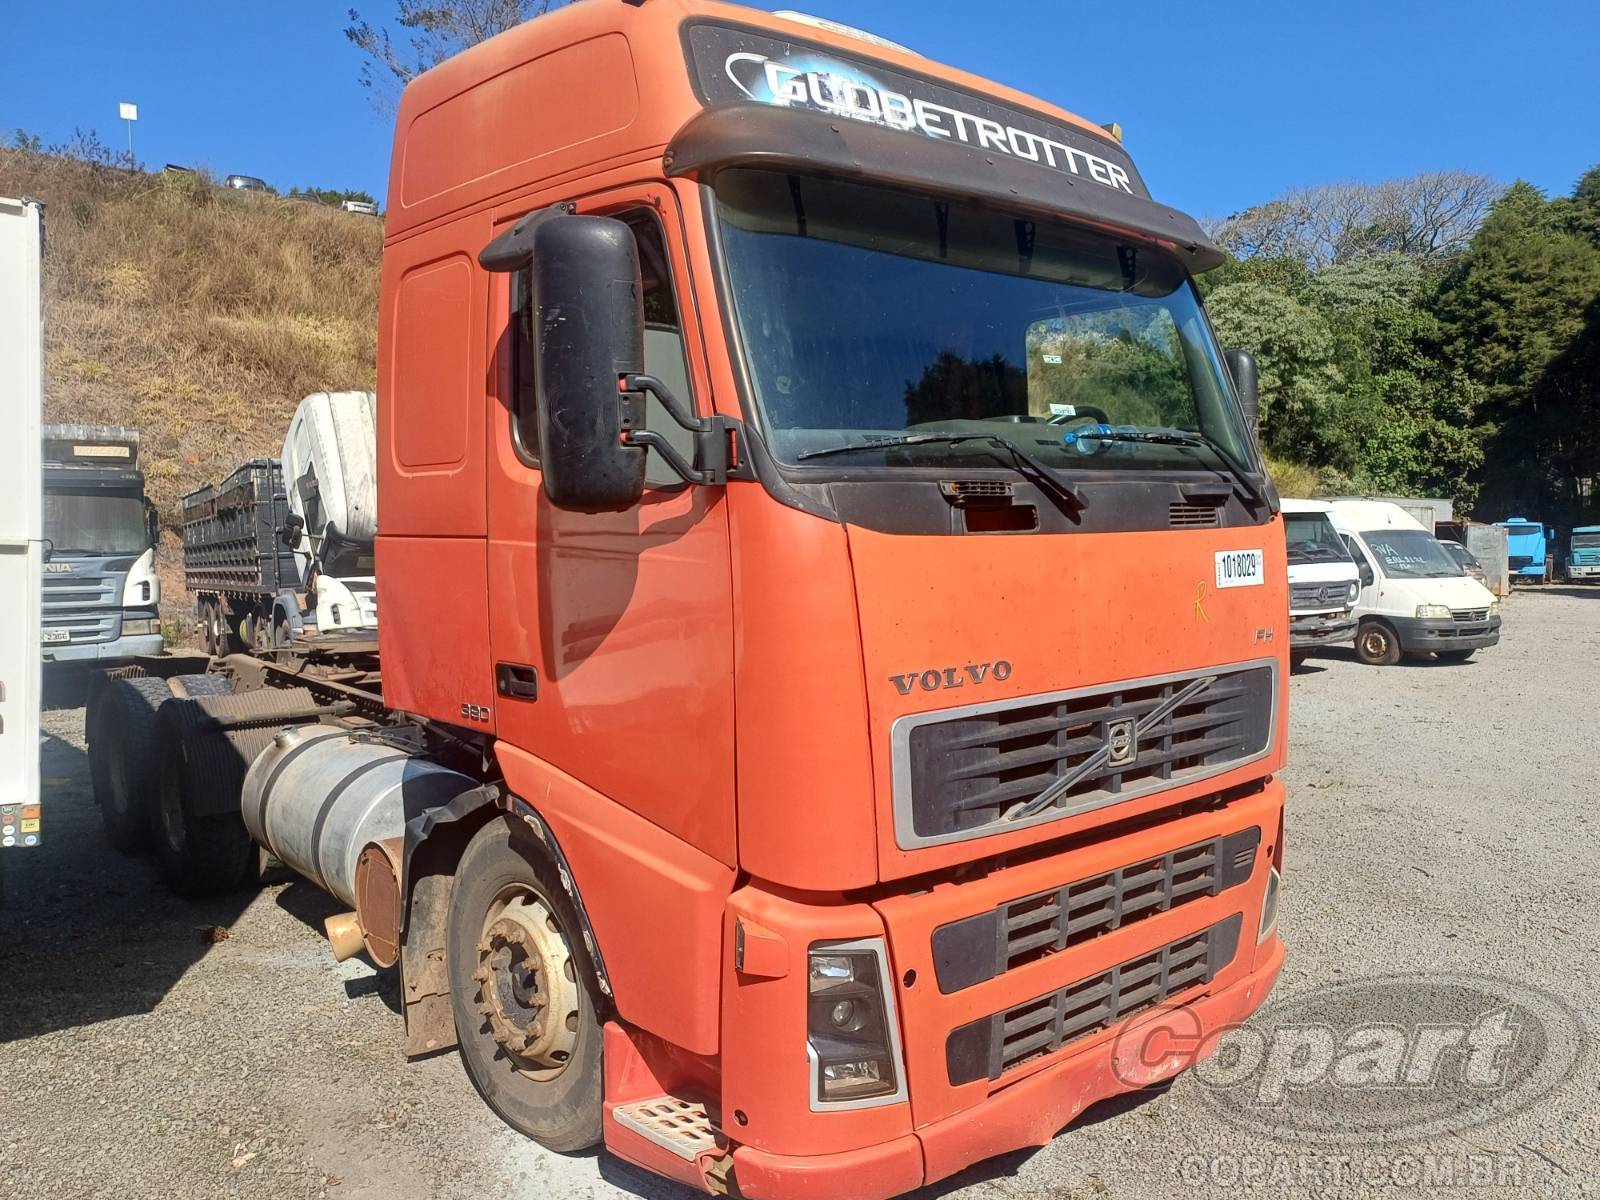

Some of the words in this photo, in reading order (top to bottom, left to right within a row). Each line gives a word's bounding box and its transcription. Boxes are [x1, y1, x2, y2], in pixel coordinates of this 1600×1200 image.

[762, 60, 1133, 195] GLOBETROTTER
[1222, 553, 1256, 579] 1018029
[1254, 627, 1273, 644] FH
[889, 660, 1012, 695] VOLVO
